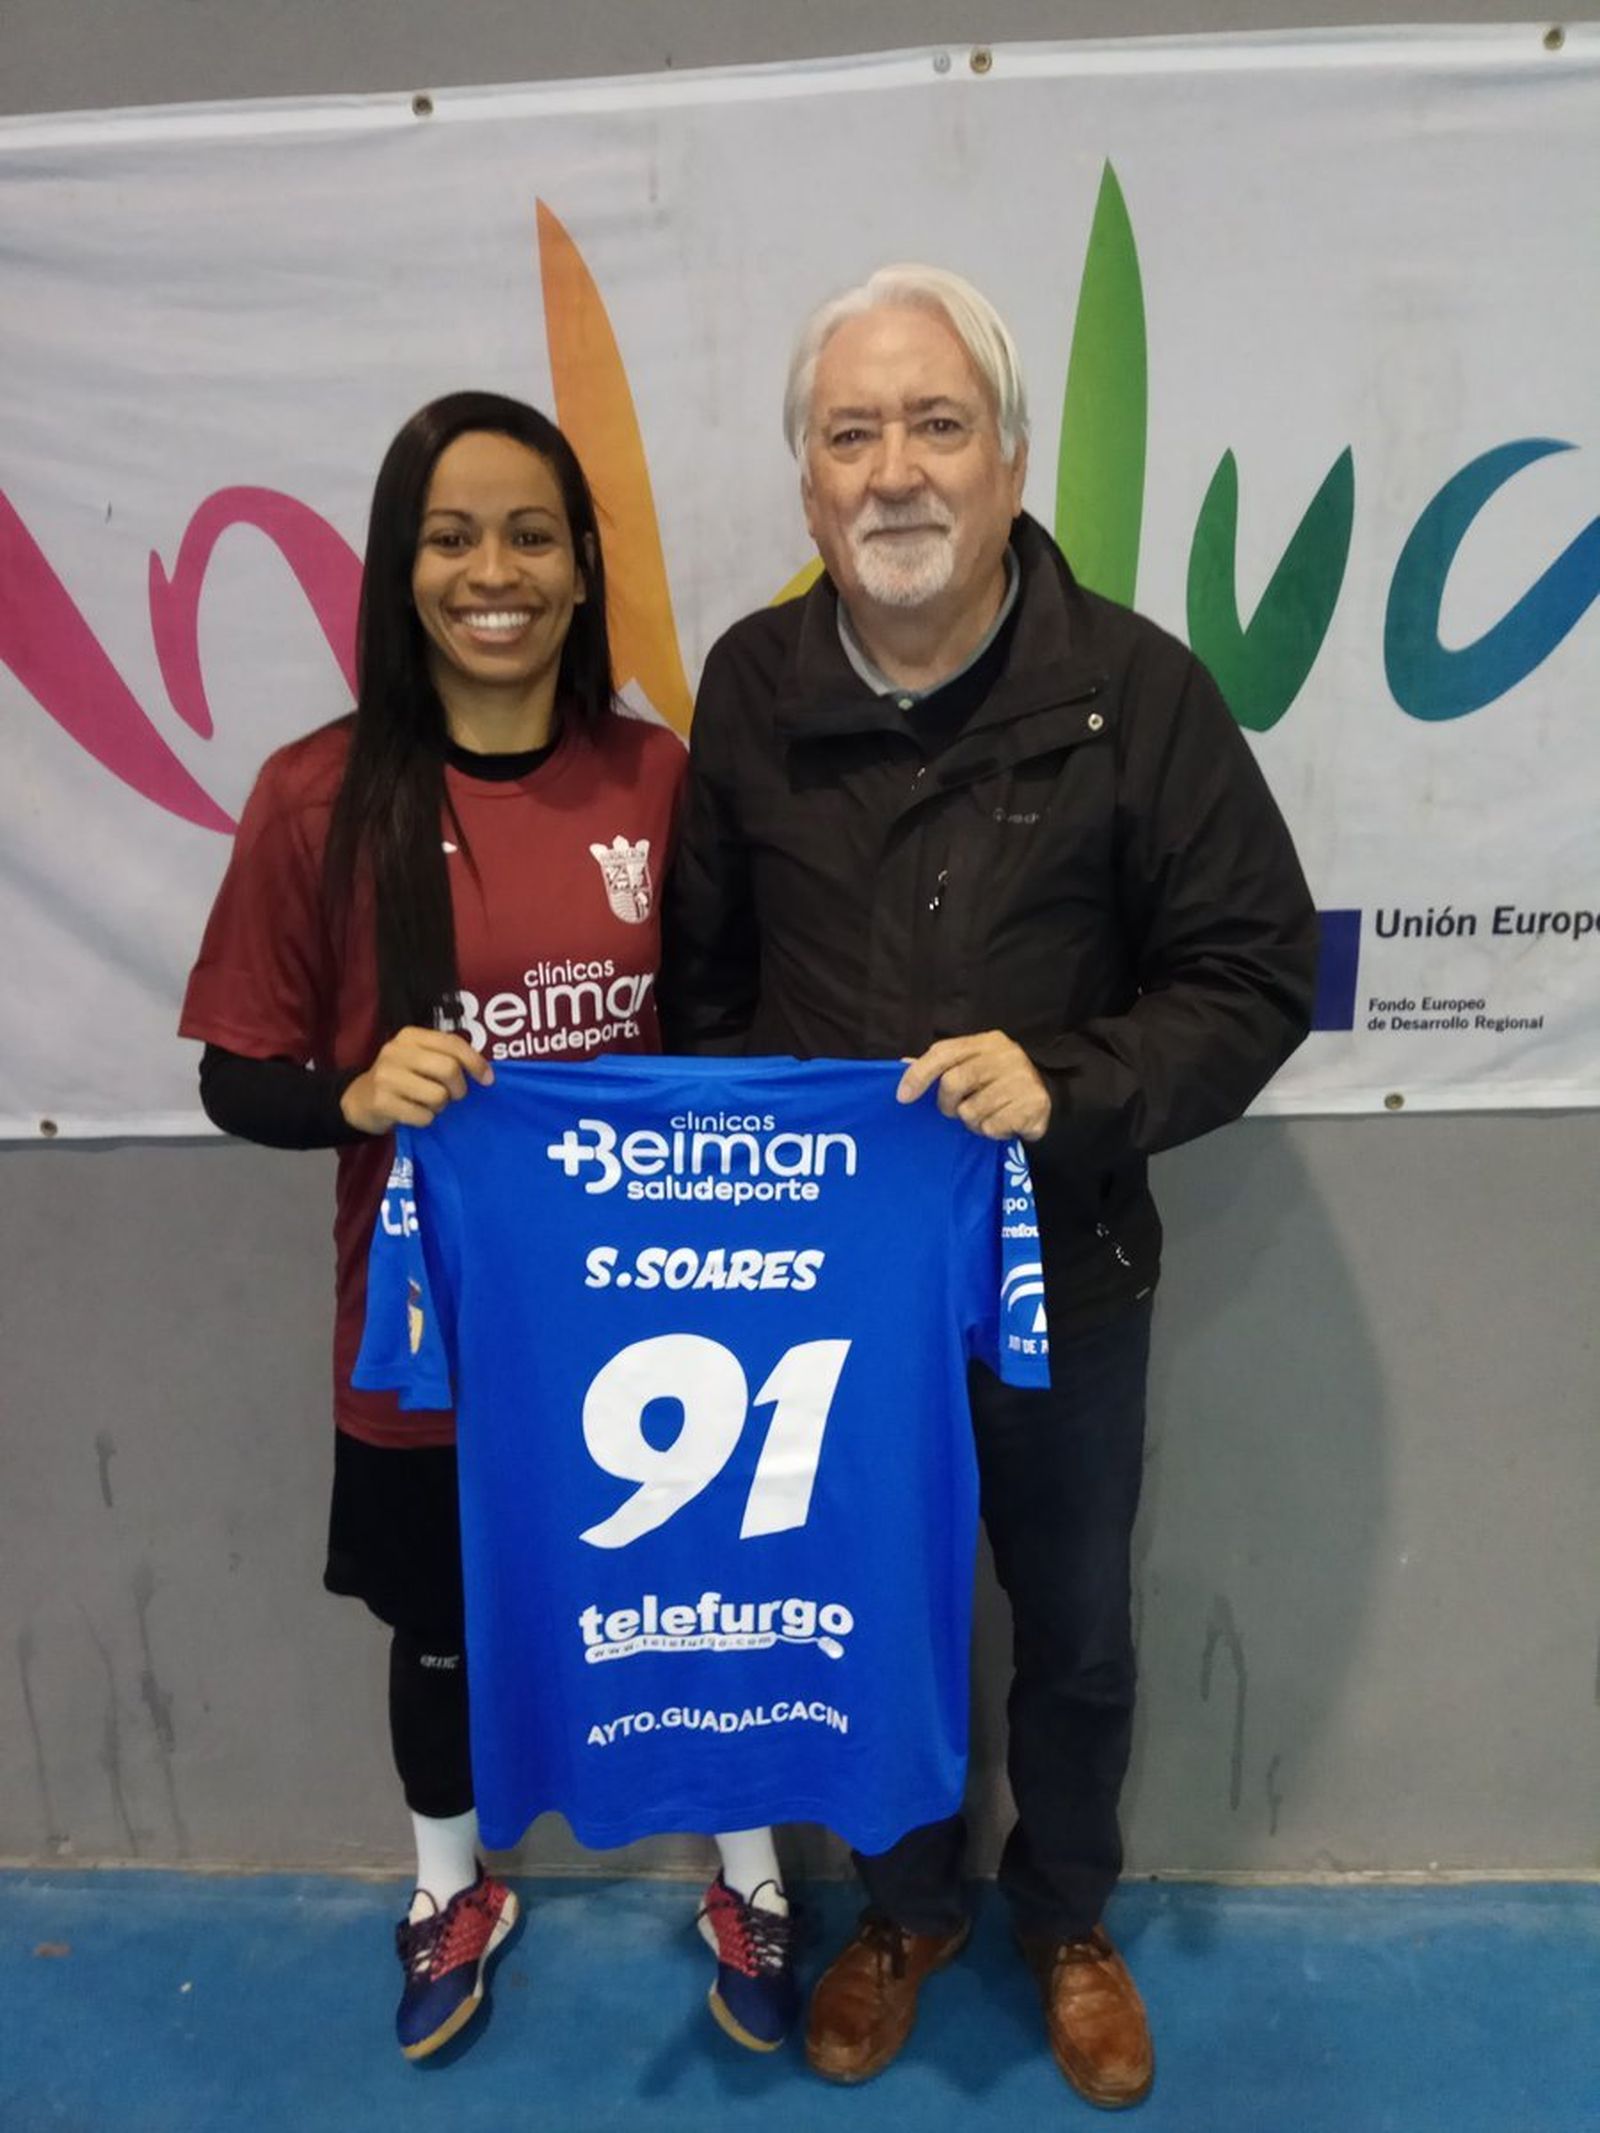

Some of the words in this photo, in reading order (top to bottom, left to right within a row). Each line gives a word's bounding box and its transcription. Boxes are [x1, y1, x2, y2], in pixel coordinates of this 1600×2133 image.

[1374, 905, 1477, 938] Unión
[1492, 904, 1600, 941] Europ
[523, 959, 615, 988] clínicas
[1368, 997, 1416, 1012] Fondo
[1421, 996, 1486, 1013] Europeo
[1367, 1017, 1386, 1031] de
[1390, 1015, 1469, 1031] Desarrollo
[1474, 1014, 1544, 1033] Regional
[547, 1118, 858, 1195] Beiman
[627, 1175, 820, 1206] saludeporte
[584, 1246, 826, 1291] S.SOARES
[579, 1333, 852, 1549] 91
[579, 1592, 854, 1647] telefurgo
